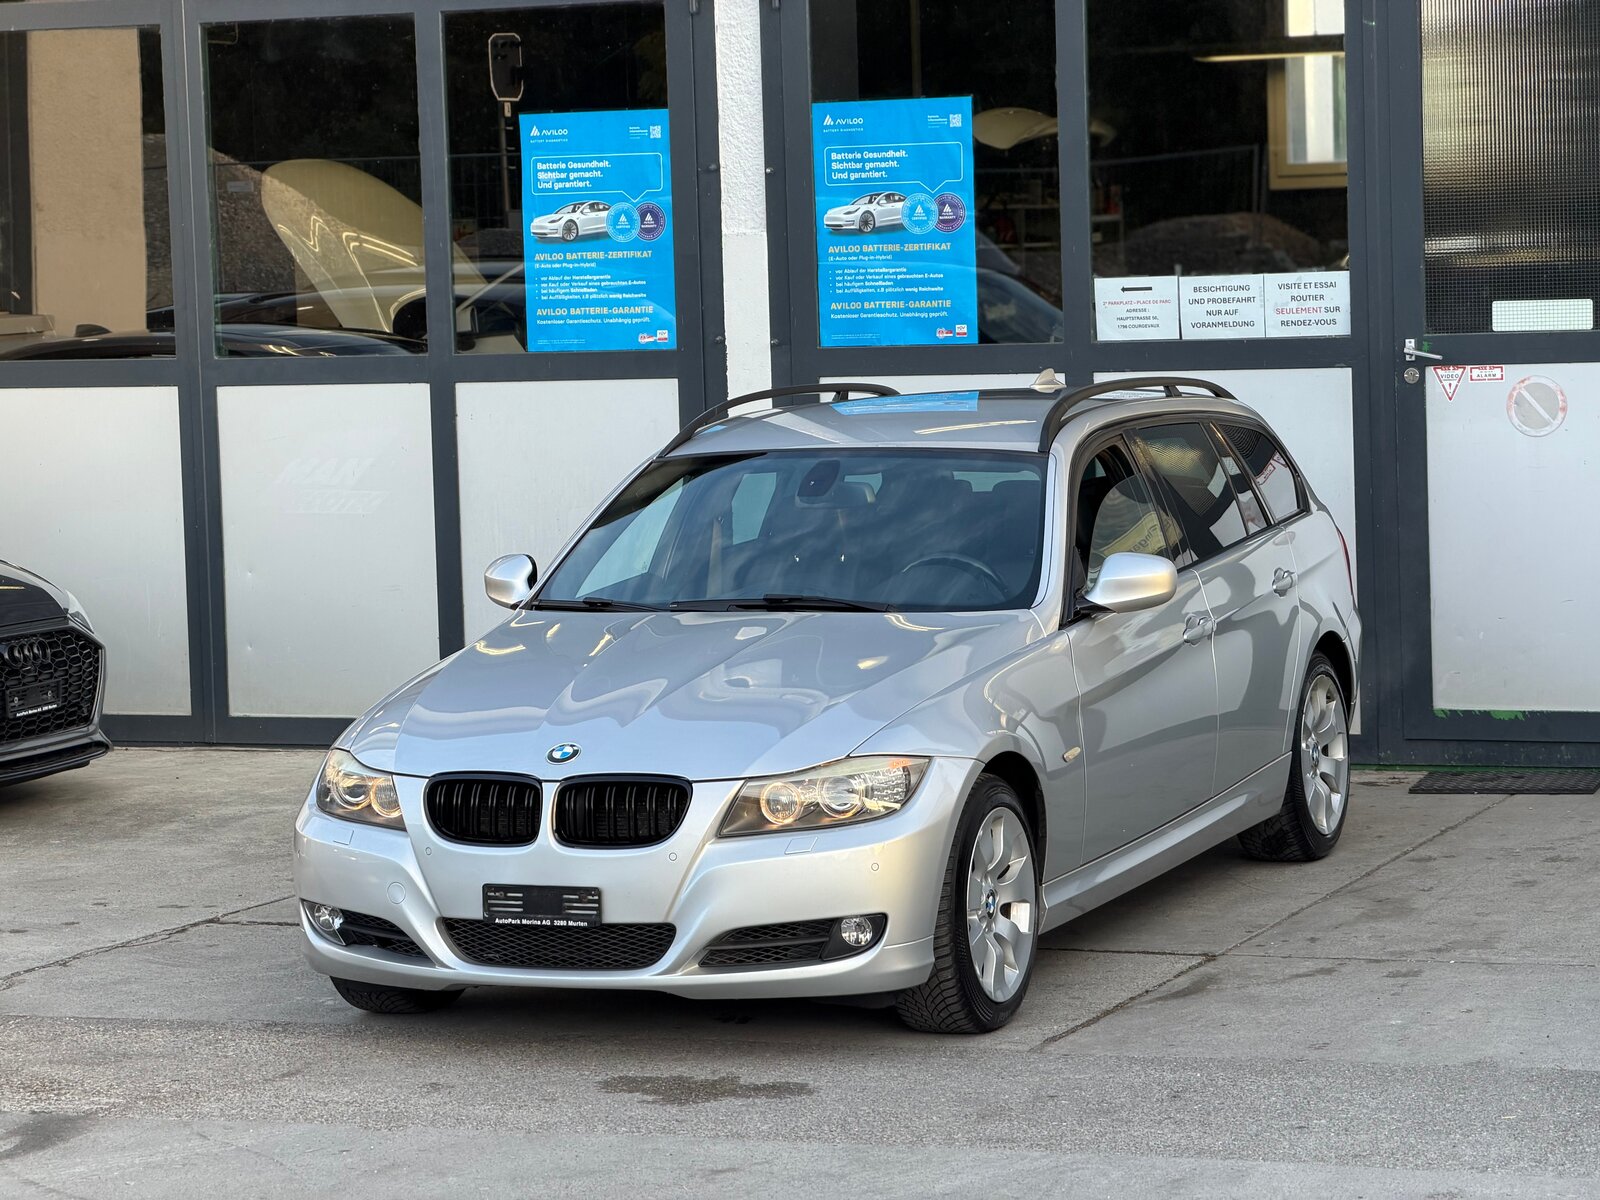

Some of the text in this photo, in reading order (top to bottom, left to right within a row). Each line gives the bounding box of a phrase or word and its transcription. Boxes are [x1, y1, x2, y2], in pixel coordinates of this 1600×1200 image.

[568, 160, 611, 169] Gesundheit.
[865, 161, 899, 170] gemacht.
[570, 171, 603, 179] gemacht.
[850, 171, 887, 180] garantiert.
[554, 181, 592, 190] garantiert.
[863, 243, 951, 252] BATTERIE-ZERTIFIKAT
[566, 251, 652, 260] BATTERIE-ZERTIFIKAT
[864, 300, 951, 309] BATTERIE-GARANTIE
[570, 306, 653, 314] BATTERIE-GARANTIE
[1191, 320, 1255, 329] VORANMELDUNG
